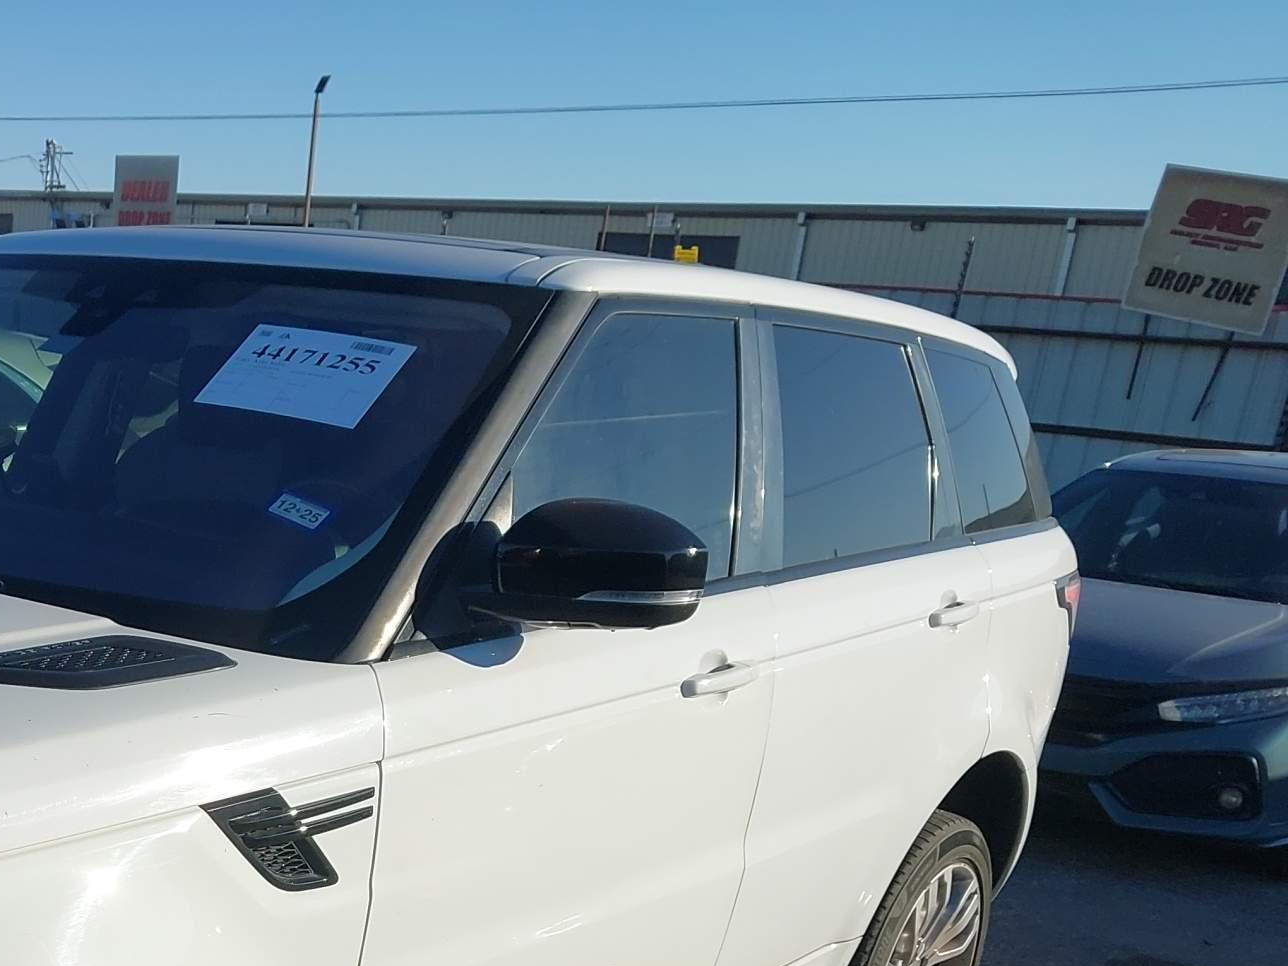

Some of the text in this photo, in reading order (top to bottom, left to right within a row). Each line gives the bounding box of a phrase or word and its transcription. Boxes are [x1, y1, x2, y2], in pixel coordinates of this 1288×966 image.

[1178, 198, 1272, 237] SRG
[1145, 267, 1261, 306] DROP ZONE
[252, 343, 381, 375] 44171255
